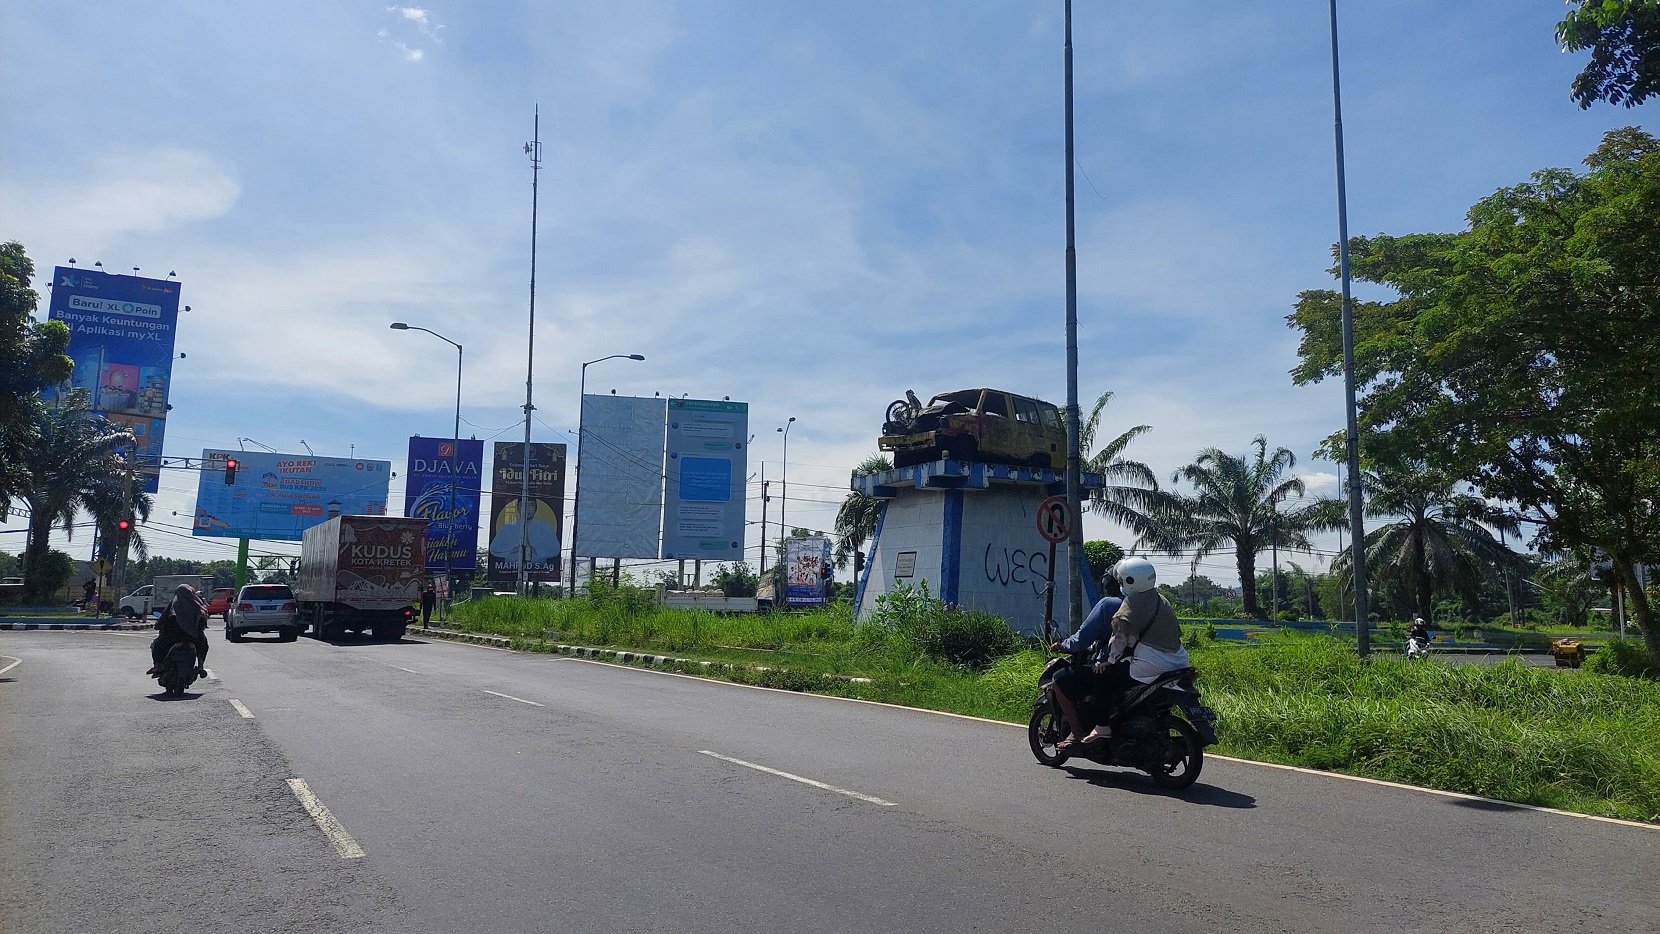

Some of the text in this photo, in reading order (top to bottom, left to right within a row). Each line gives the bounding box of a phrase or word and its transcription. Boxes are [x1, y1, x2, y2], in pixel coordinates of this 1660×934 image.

[72, 298, 158, 316] Baru! XL Poin
[56, 310, 170, 331] Banyak Keuntungan
[77, 324, 124, 337] Aplikasi
[128, 331, 161, 341] myXL
[209, 452, 230, 460] KPK
[413, 459, 478, 474] DJAVA
[529, 469, 558, 481] Fitri
[438, 523, 473, 531] Bluberry
[351, 545, 412, 559] KUDUS
[534, 563, 555, 571] S.Ag
